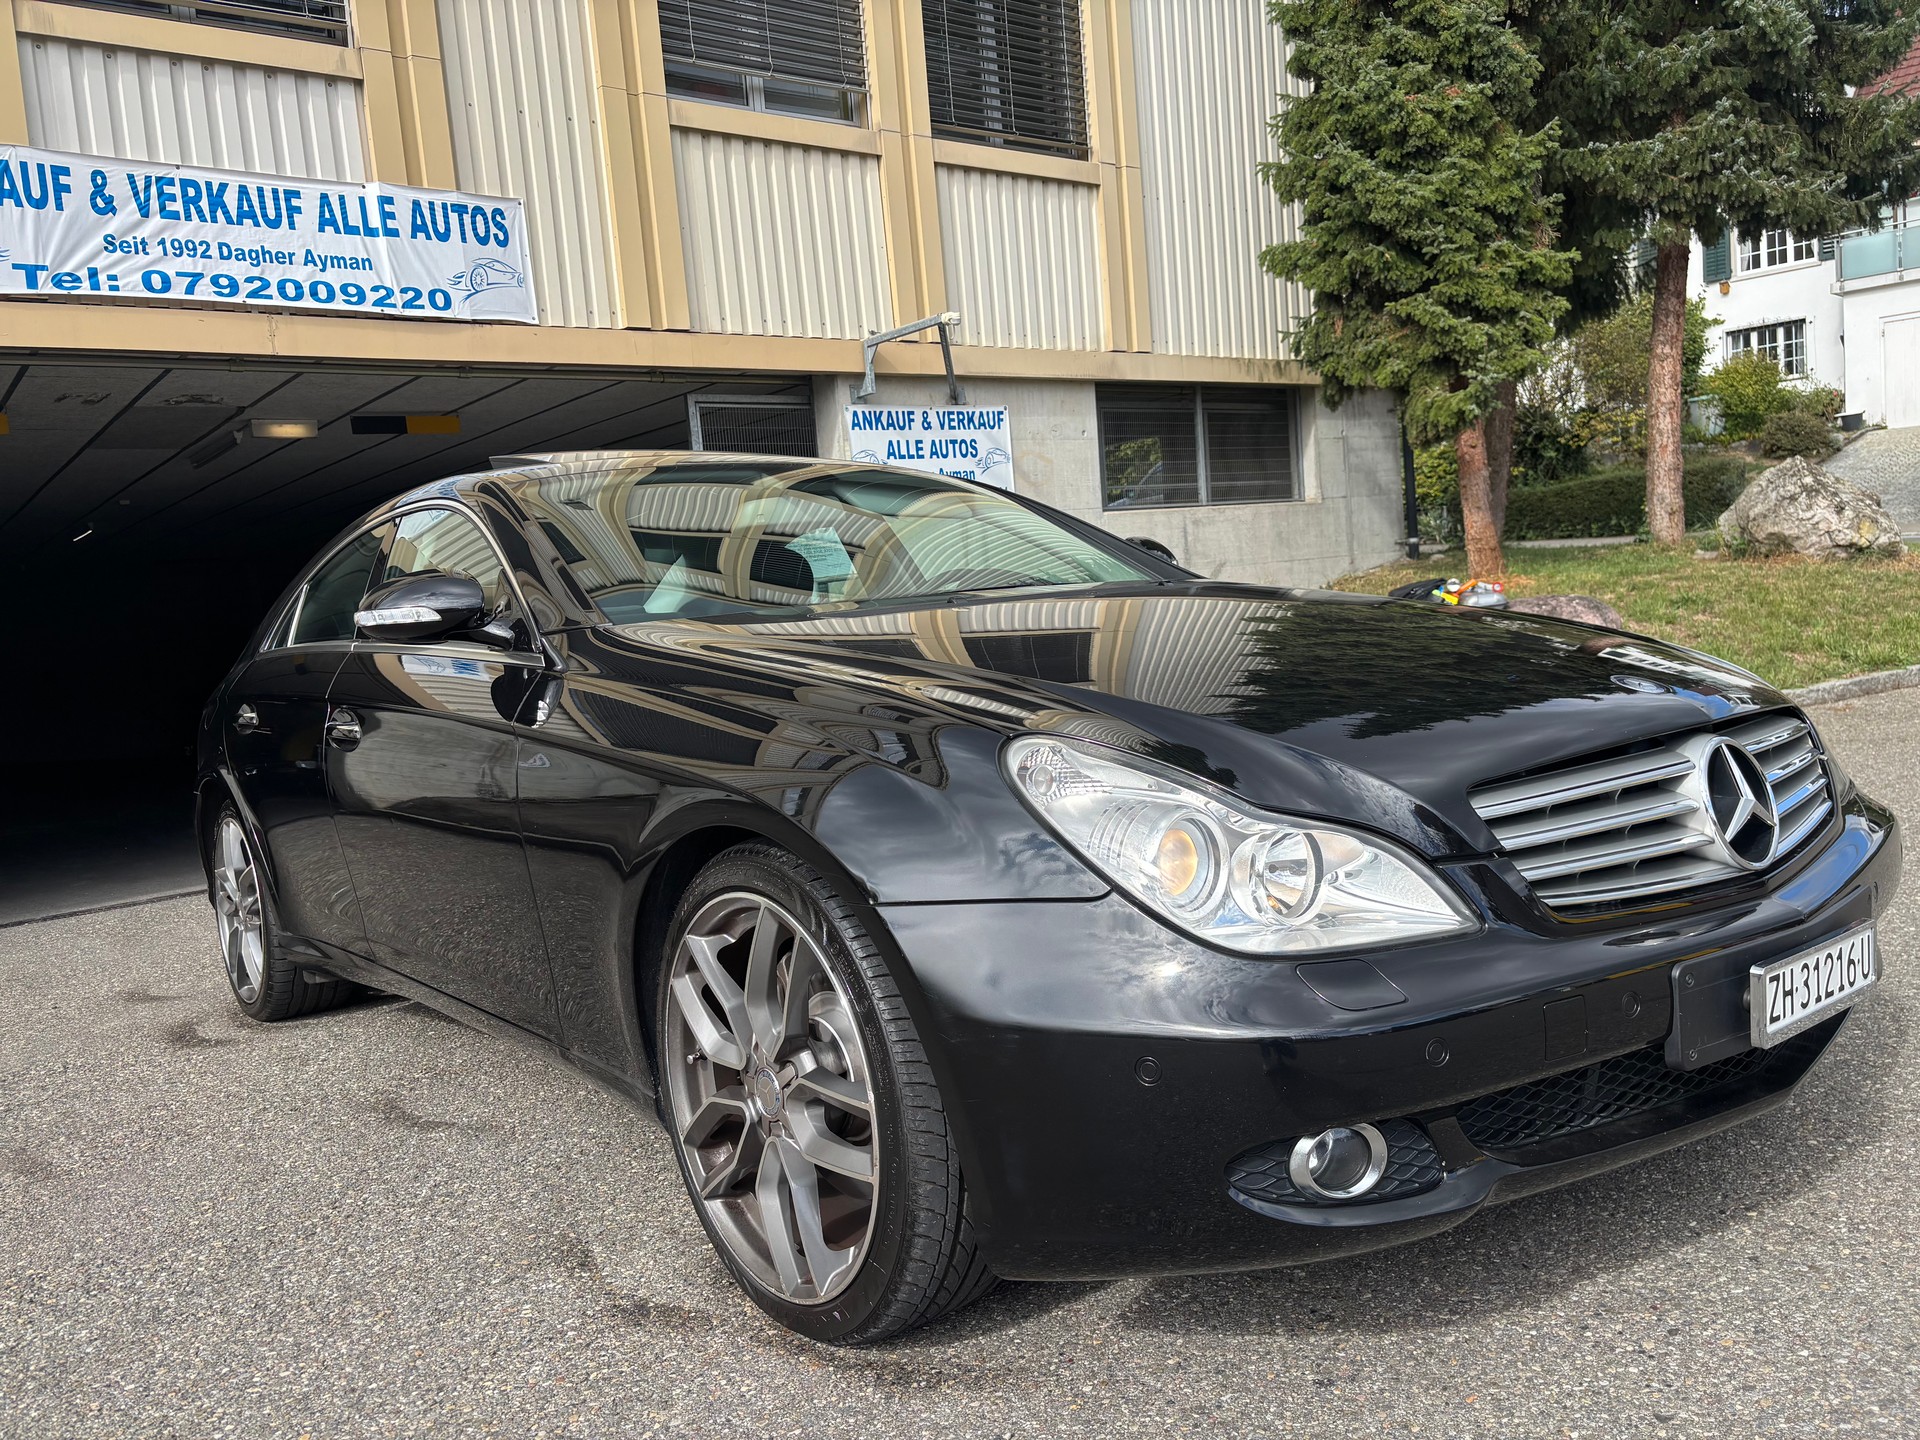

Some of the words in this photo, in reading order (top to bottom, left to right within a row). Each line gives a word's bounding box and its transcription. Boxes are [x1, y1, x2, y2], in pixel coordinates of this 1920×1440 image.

[89, 169, 118, 217] &
[126, 173, 303, 230] VERKAUF
[318, 192, 400, 239] ALLE
[410, 199, 510, 248] AUTOS
[102, 233, 150, 256] Seit
[157, 237, 213, 260] 1992
[218, 241, 296, 267] Dagher
[303, 248, 374, 273] Ayman
[11, 262, 121, 293] Tel:
[141, 269, 452, 312] 0792009220
[851, 410, 916, 431] ANKAUF
[921, 410, 933, 431] &
[935, 410, 1005, 430] VERKAUF
[886, 439, 925, 460] ALLE
[929, 438, 978, 459] AUTOS
